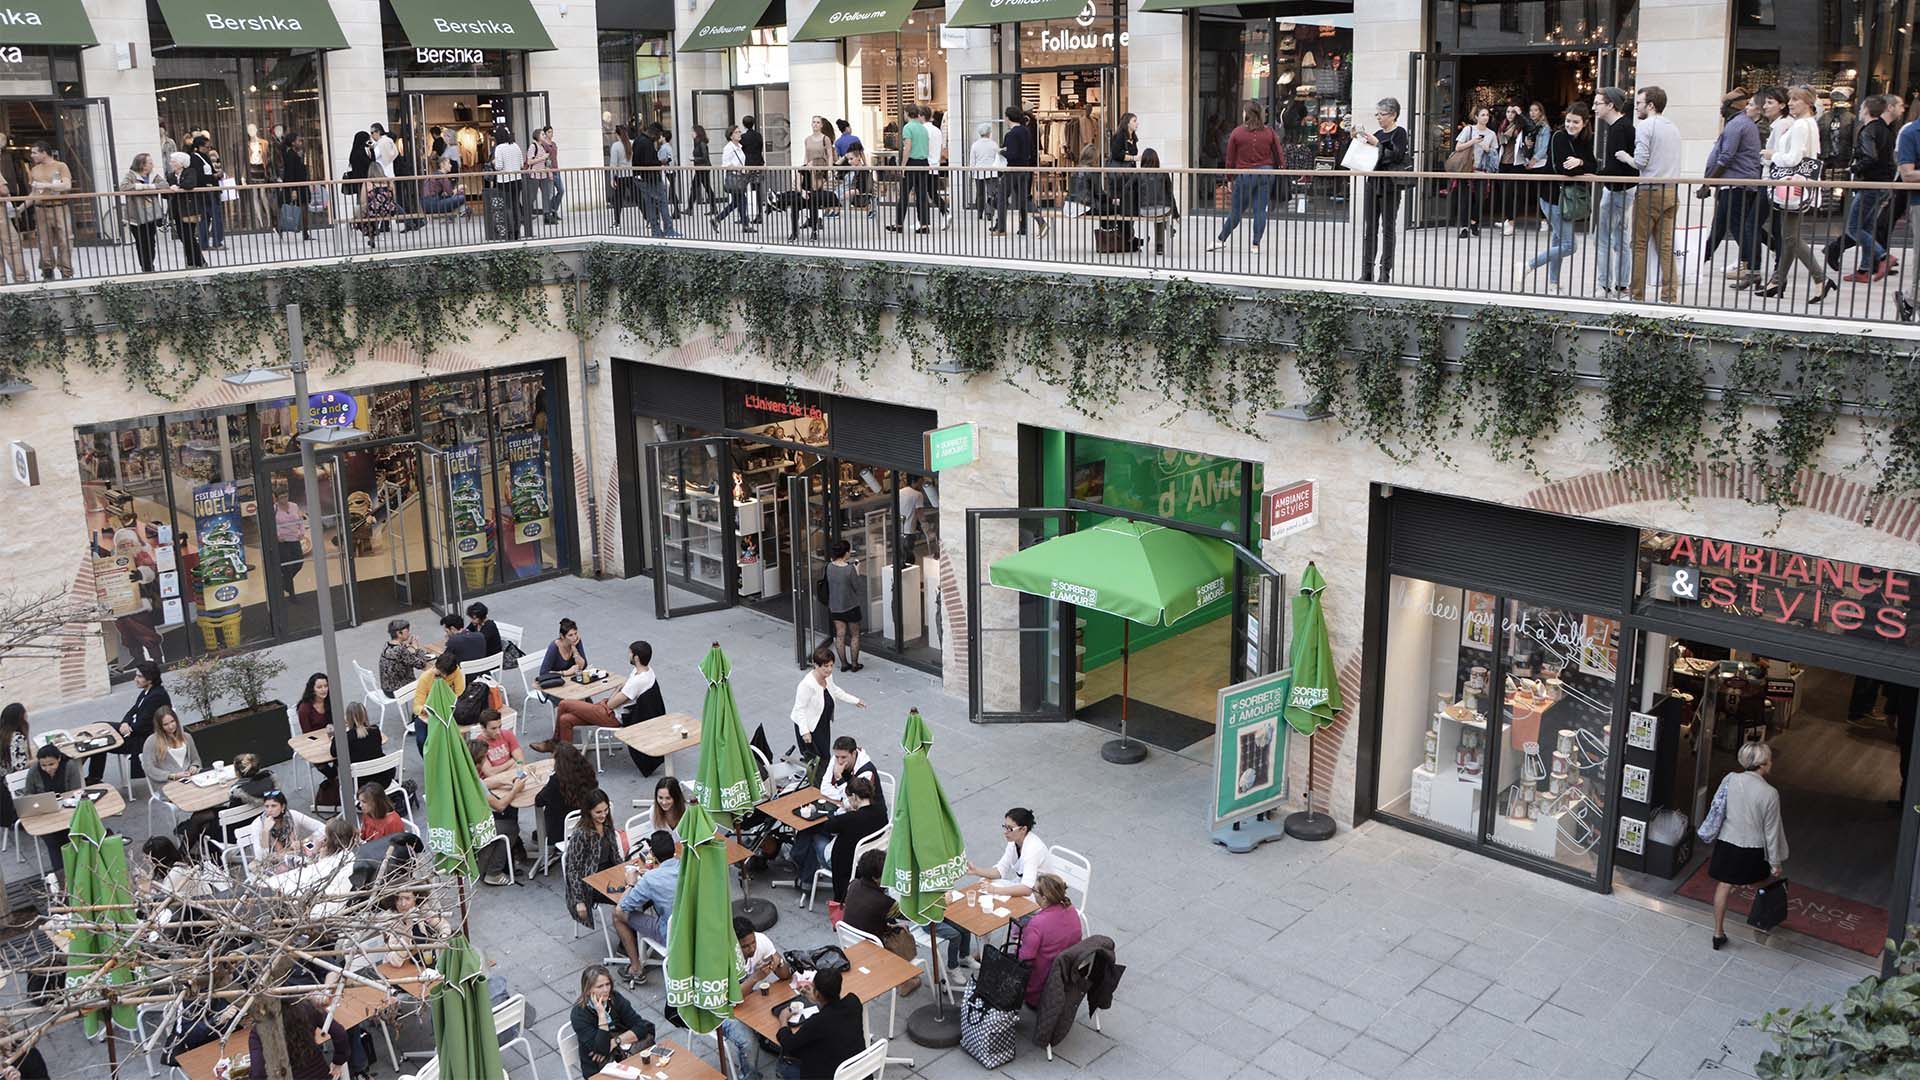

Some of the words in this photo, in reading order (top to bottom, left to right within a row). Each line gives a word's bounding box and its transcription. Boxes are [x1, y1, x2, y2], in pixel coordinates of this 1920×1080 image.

[205, 13, 302, 31] Bershka
[841, 12, 870, 22] Follow
[872, 10, 886, 18] me
[433, 18, 515, 34] Bershka
[1041, 29, 1097, 52] Follow
[416, 47, 484, 64] Bershka
[321, 394, 335, 404] La
[745, 394, 788, 415] L'Univers
[309, 403, 349, 416] Grande
[1275, 489, 1310, 510] AMBIANCE
[1281, 500, 1310, 517] styles
[1670, 535, 1911, 602] AMBIANCE
[1059, 581, 1090, 597] SORBET
[1057, 591, 1090, 607] AMOUR
[1671, 569, 1694, 598] &
[1709, 577, 1907, 639] styles
[1239, 692, 1274, 710] SORBET
[1239, 702, 1274, 723] AMOUR
